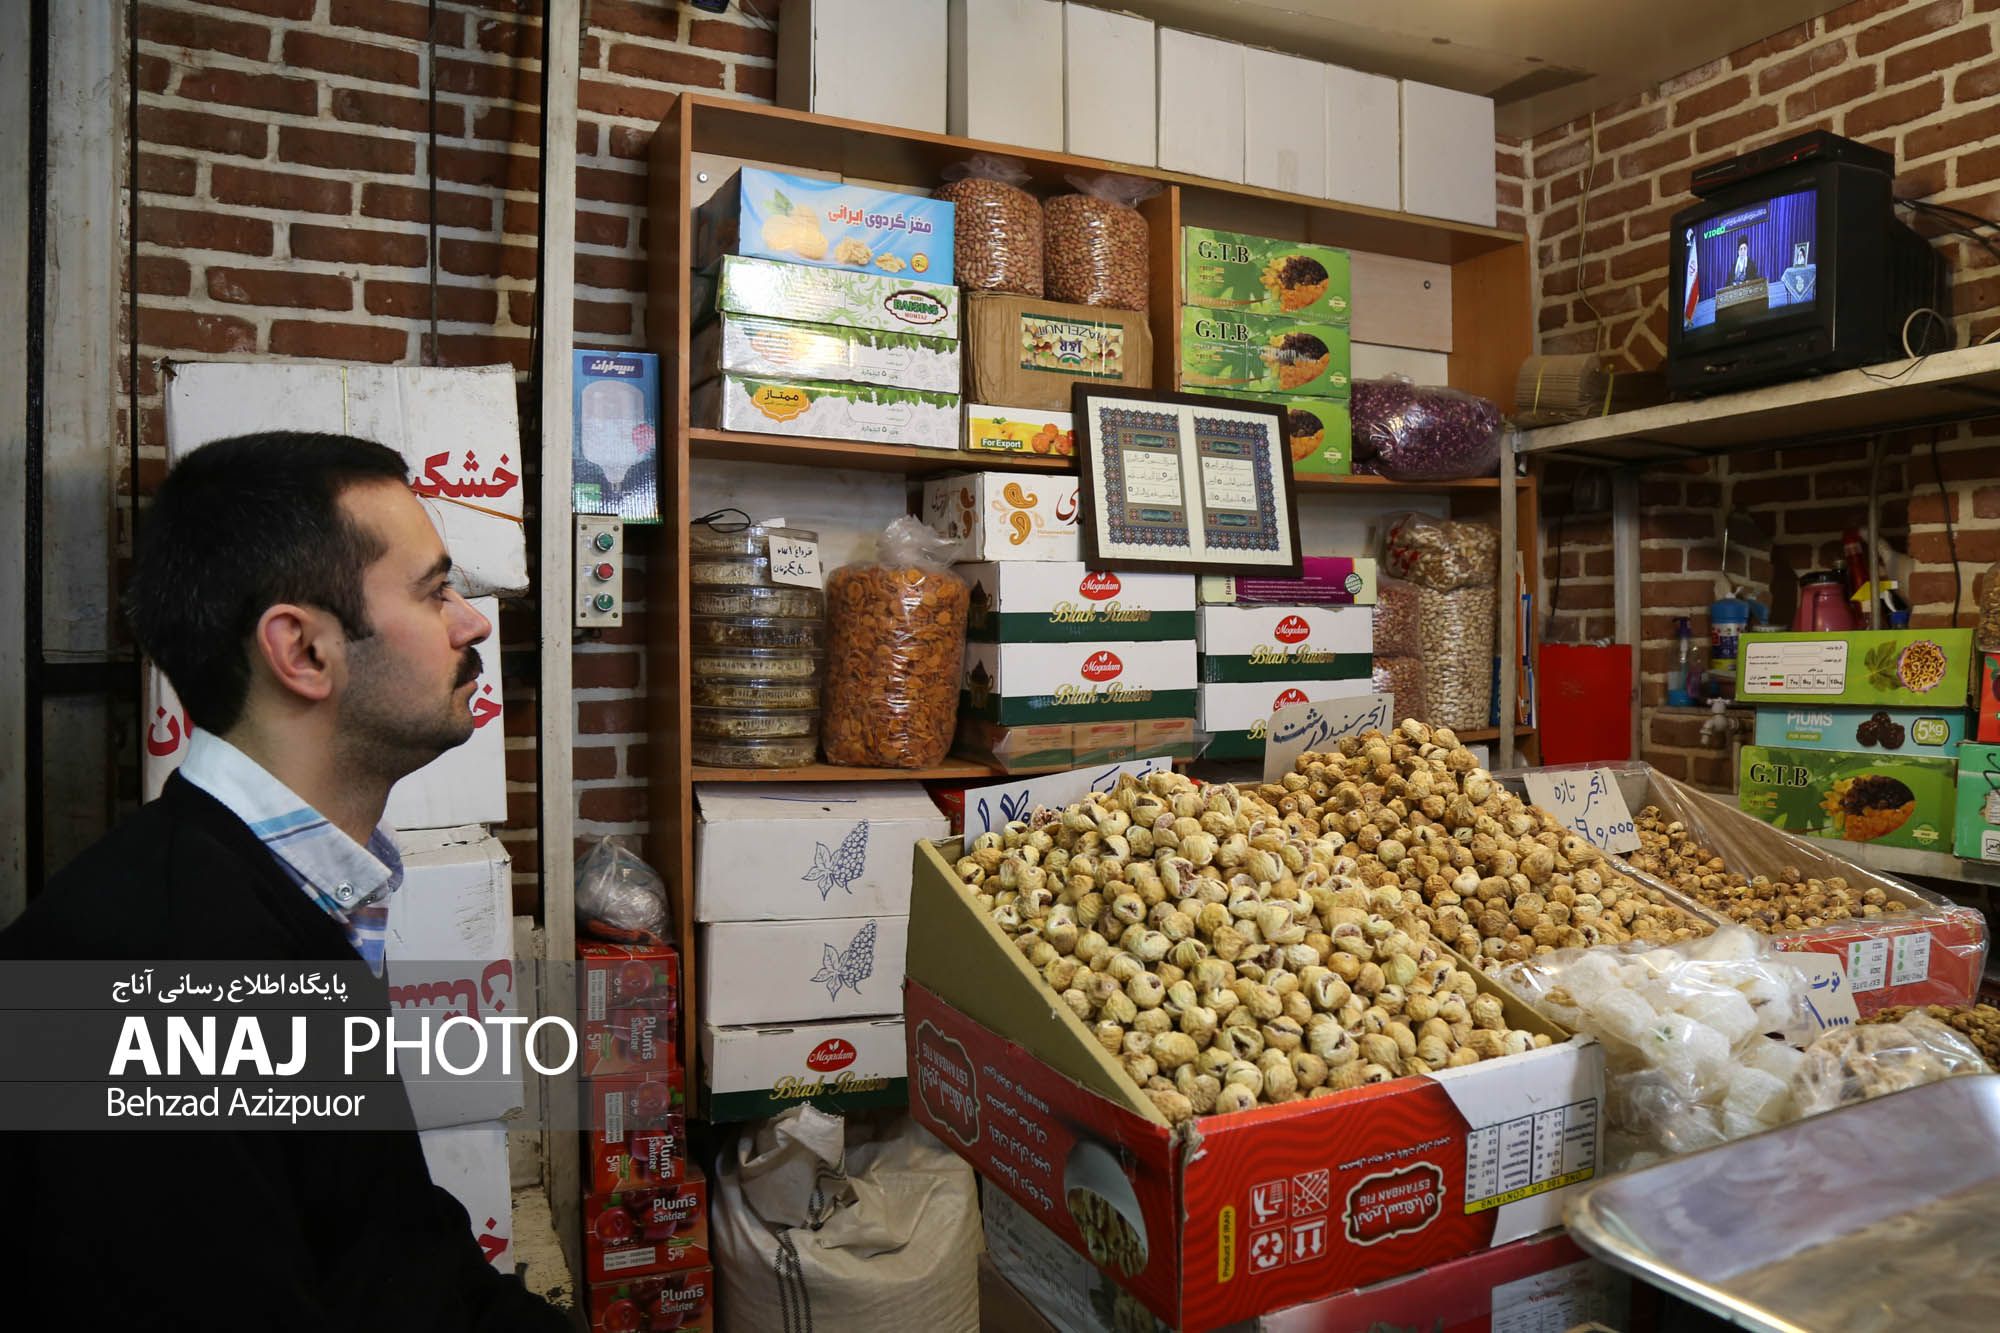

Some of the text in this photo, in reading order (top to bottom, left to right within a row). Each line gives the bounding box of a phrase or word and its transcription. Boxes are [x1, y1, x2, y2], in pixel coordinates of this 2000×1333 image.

[828, 204, 932, 234] مغز گردوی ایرانی
[1703, 226, 1726, 240] VIDEO
[1198, 240, 1250, 264] G.T.B
[893, 299, 939, 316] RAISINS
[1195, 319, 1249, 342] G.T.B
[981, 438, 1023, 450] For Export
[1081, 580, 1119, 594] Mogadam
[1049, 601, 1096, 624] Black
[1274, 626, 1309, 638] Mogadam
[1248, 643, 1289, 665] Black
[1082, 661, 1121, 676] Mogadam
[1051, 682, 1098, 706] Black
[1273, 708, 1328, 752] درشت
[1750, 763, 1809, 787] G.T.B
[1554, 778, 1576, 805] تازه
[642, 1016, 657, 1060] Plums
[808, 1050, 854, 1065] Mogadam
[769, 1075, 825, 1100] Black
[660, 1135, 674, 1179] Plums
[1360, 1178, 1431, 1206] ESTAHBAN FIG
[1480, 1189, 1526, 1209] CONTAINS
[653, 1196, 697, 1212] Plums
[653, 1211, 687, 1223] Santrize
[1222, 1211, 1231, 1232] IRAN
[1222, 1247, 1231, 1278] Product
[661, 1287, 705, 1303] Plums
[661, 1302, 695, 1314] Santrize
